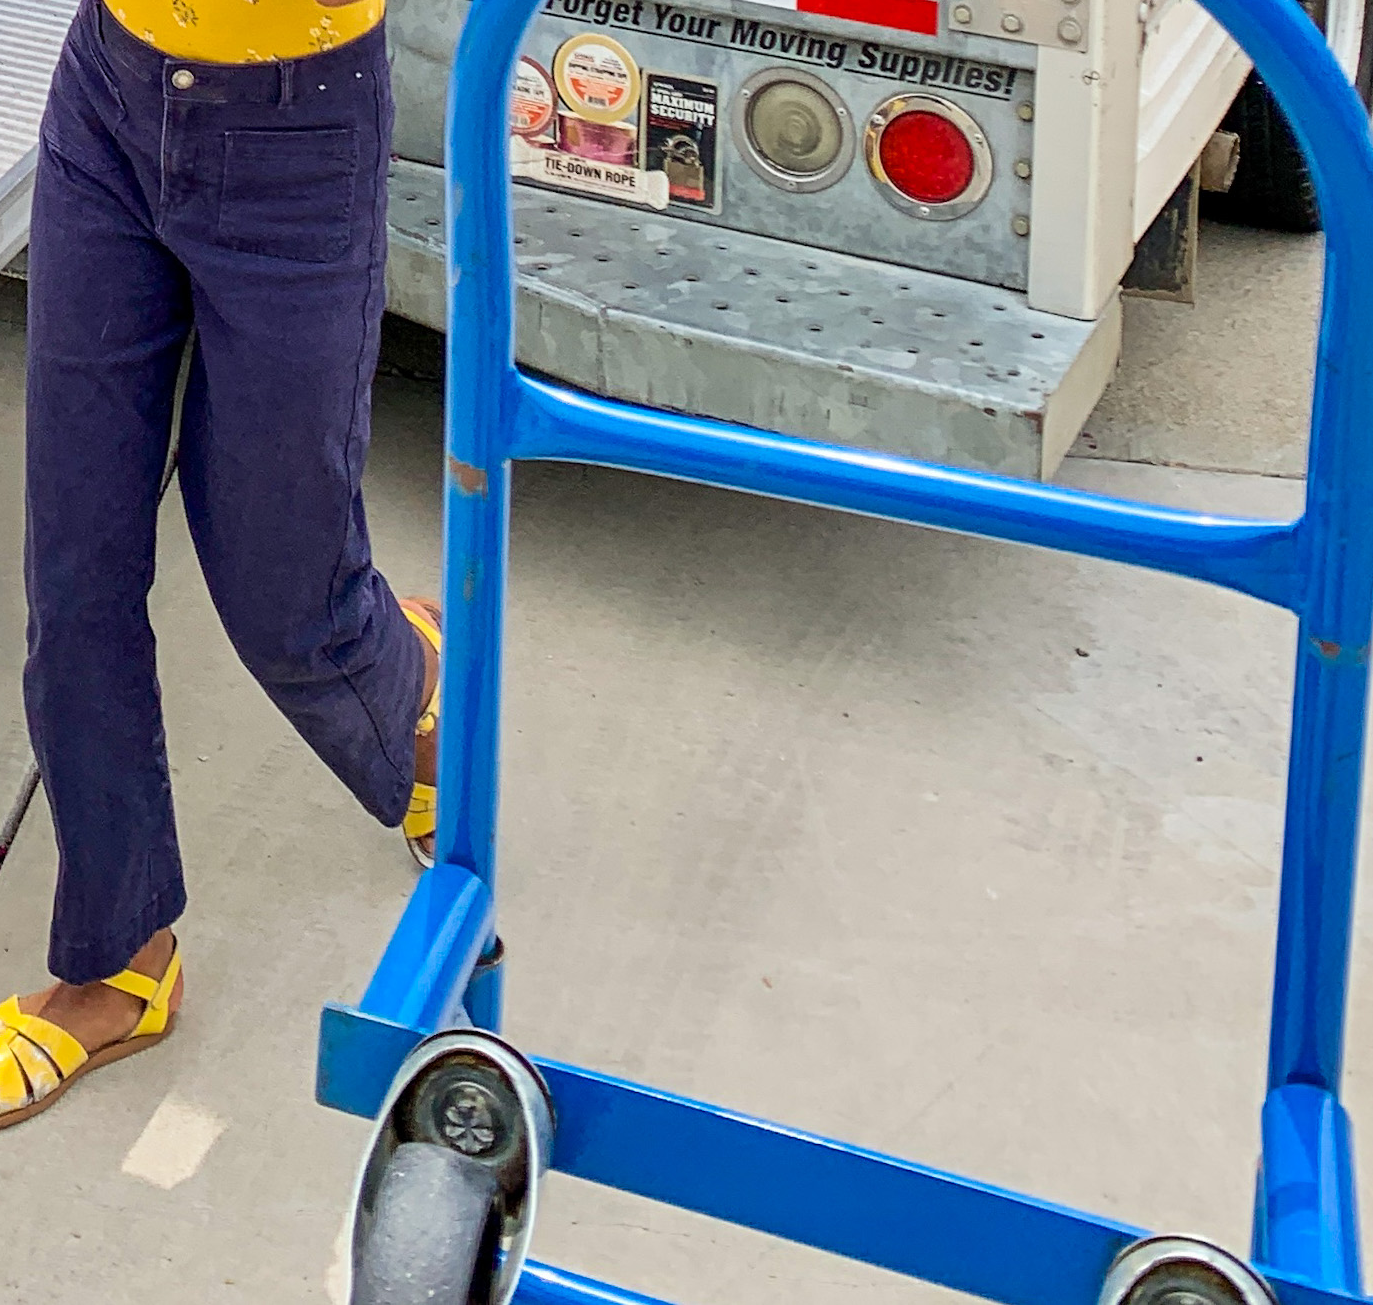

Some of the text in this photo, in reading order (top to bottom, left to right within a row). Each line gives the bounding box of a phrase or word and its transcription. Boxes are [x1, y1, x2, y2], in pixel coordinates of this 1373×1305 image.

[654, 2, 721, 39] Your
[729, 18, 848, 70] Moving
[858, 41, 1019, 95] Supplies!
[650, 92, 715, 115] MAXIMUM
[650, 103, 716, 127] SECURITY
[545, 157, 636, 188] TIE-DOWN ROPE
